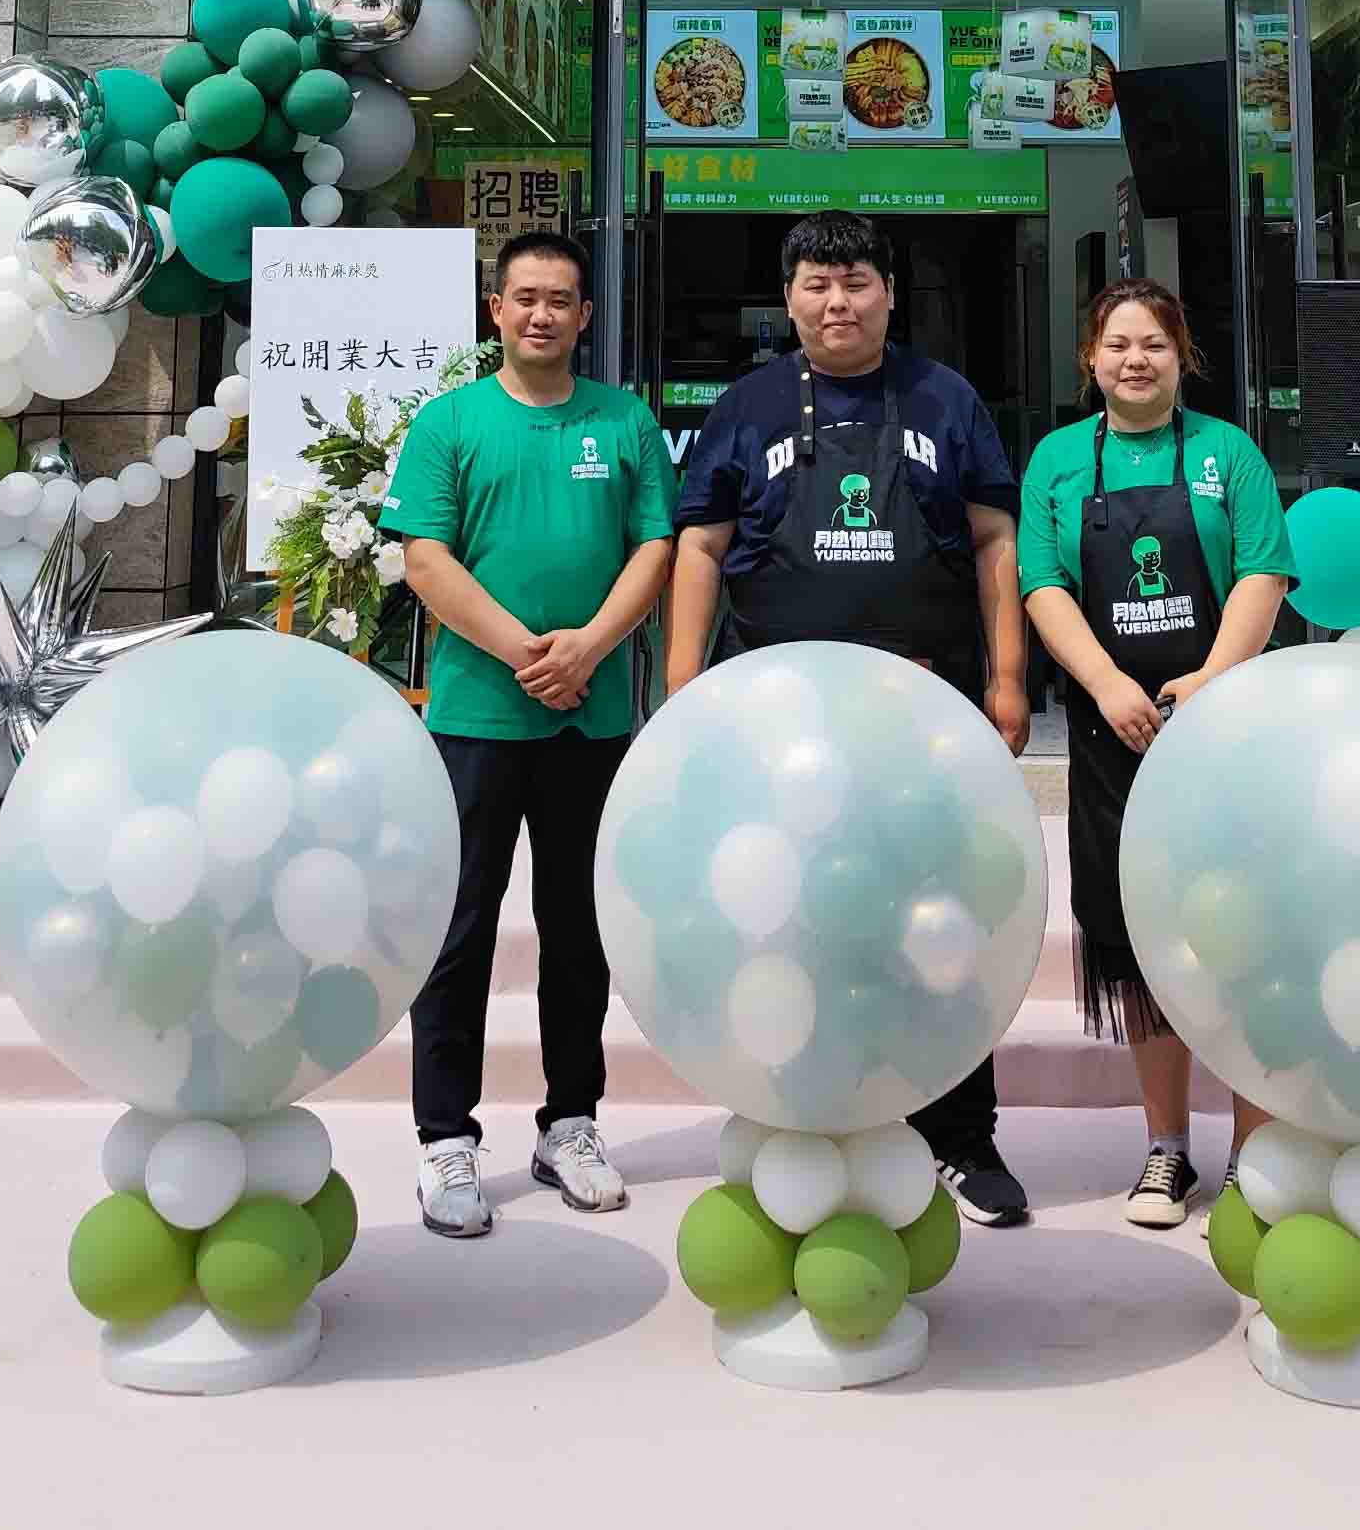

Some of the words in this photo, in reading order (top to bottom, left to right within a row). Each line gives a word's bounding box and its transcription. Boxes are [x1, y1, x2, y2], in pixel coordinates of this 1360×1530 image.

[469, 169, 561, 219] 招聘
[260, 339, 440, 372] 祝開業大吉
[813, 530, 868, 549] 月热情
[814, 549, 895, 562] YUEREQING
[1112, 599, 1166, 622] 月热情
[1113, 615, 1196, 635] YUEREQING
